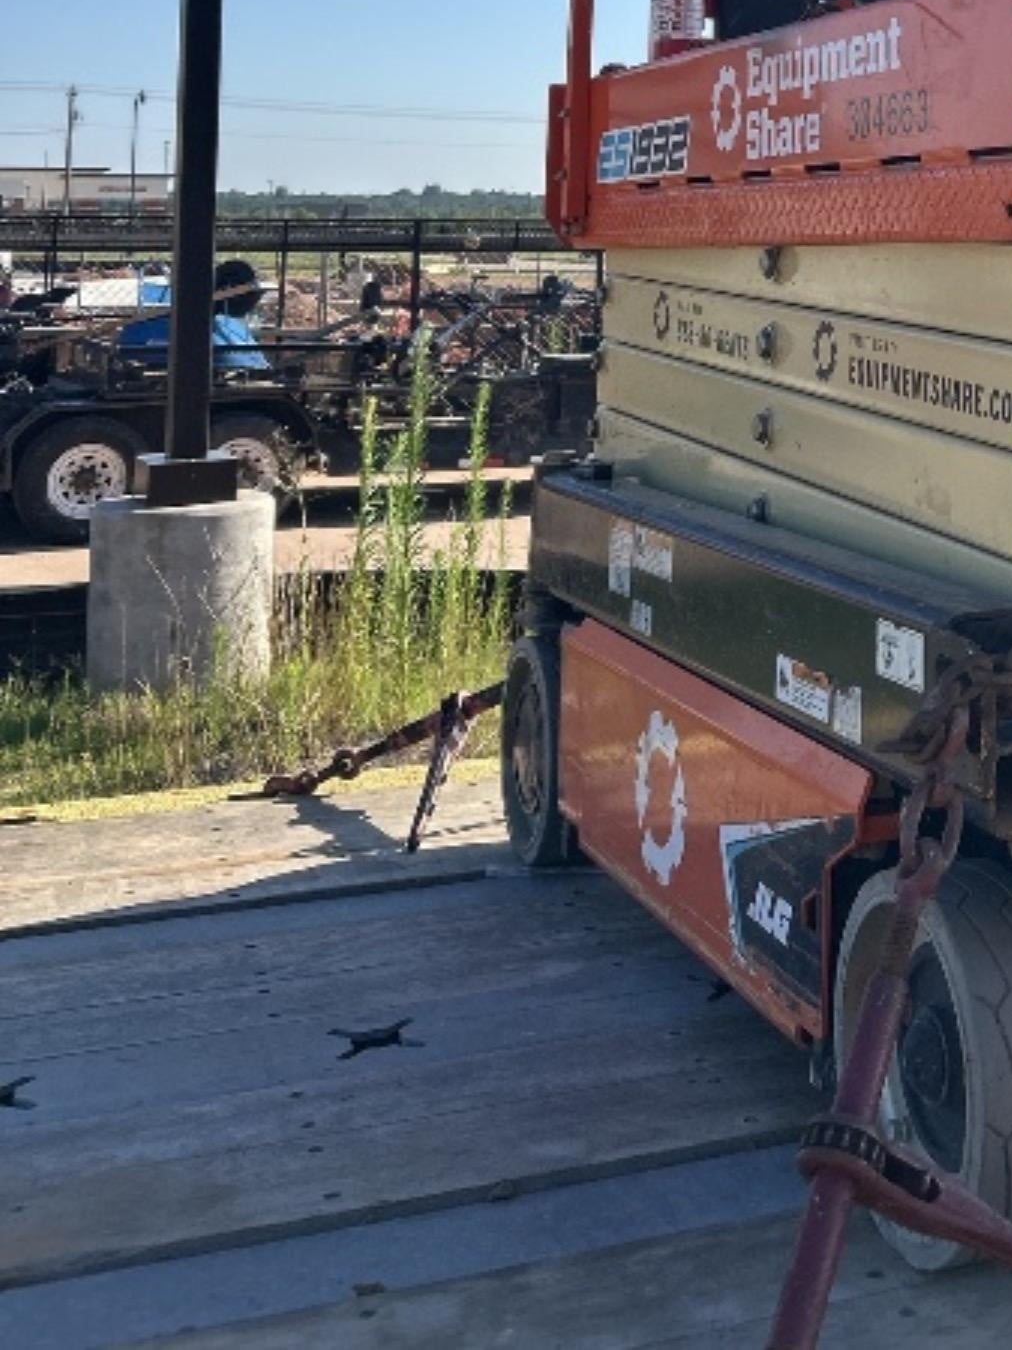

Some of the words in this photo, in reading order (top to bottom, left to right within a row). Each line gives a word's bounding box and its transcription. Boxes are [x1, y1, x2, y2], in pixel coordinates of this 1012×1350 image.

[747, 16, 902, 106] Equipment
[746, 107, 821, 160] Share
[746, 881, 793, 947] JLG
